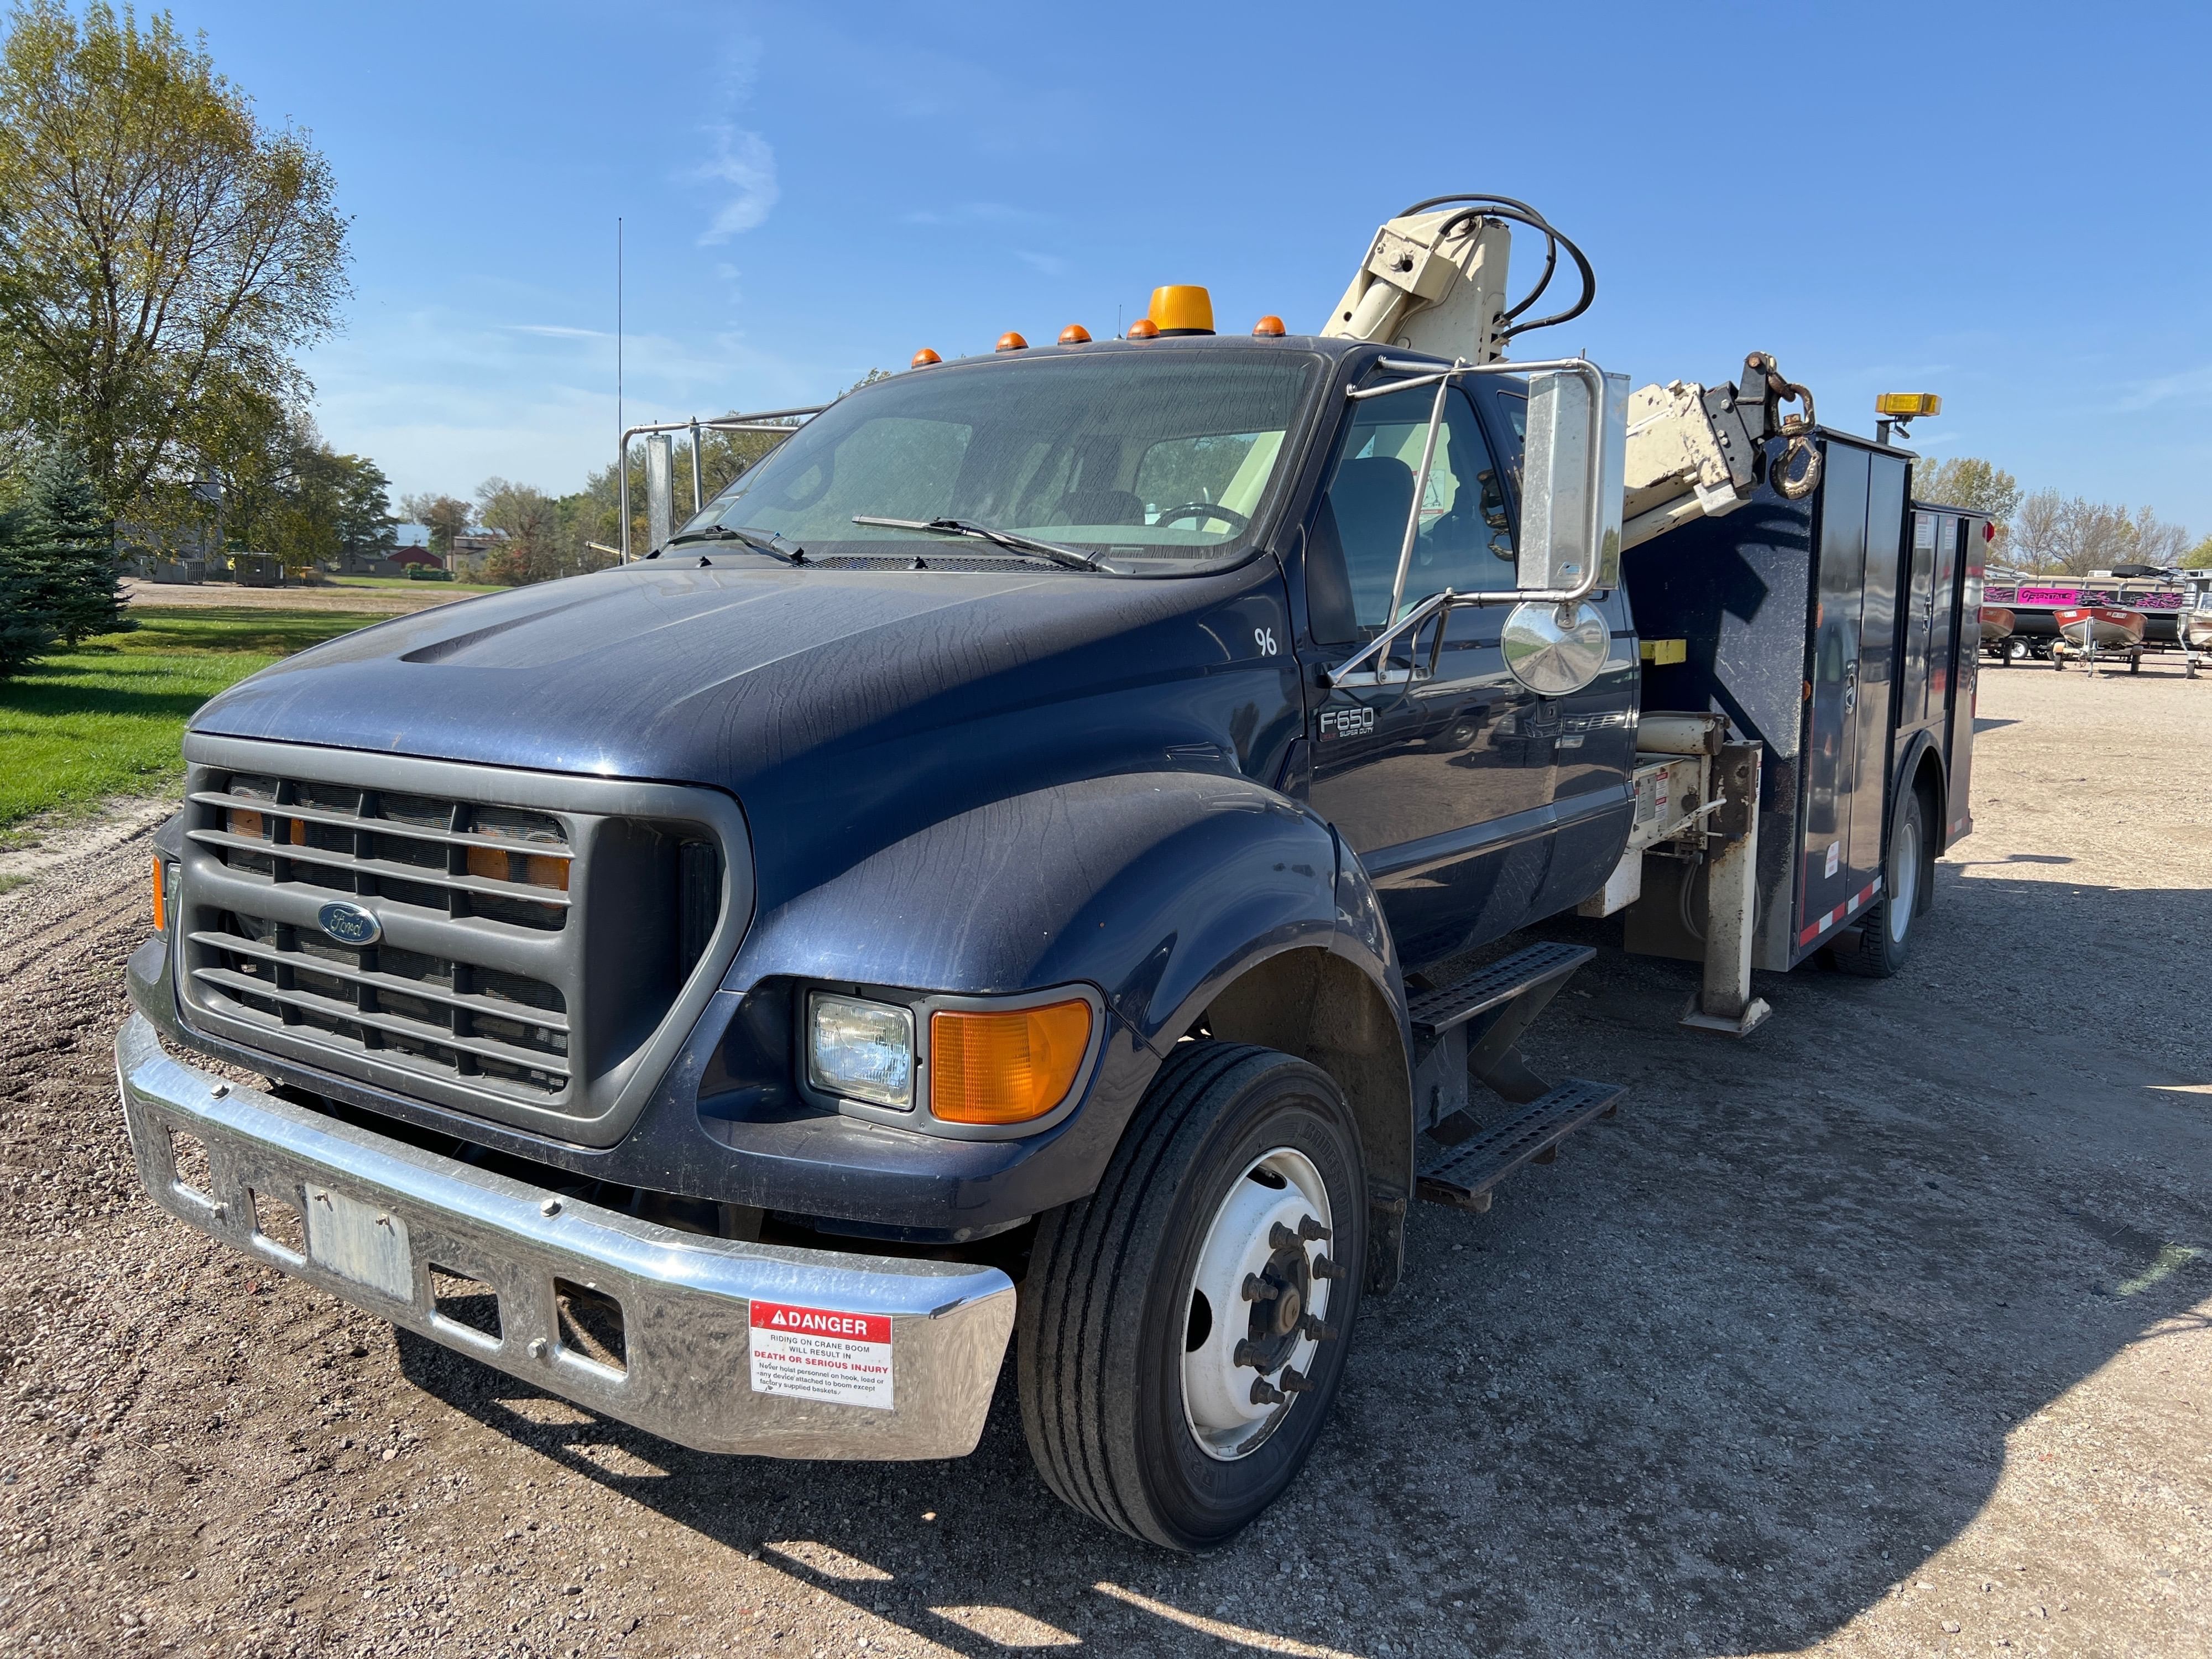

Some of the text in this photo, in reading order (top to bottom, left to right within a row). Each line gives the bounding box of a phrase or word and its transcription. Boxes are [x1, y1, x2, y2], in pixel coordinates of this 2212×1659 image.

[1254, 627, 1277, 656] 96
[330, 909, 363, 937] Ford
[1300, 1120, 1350, 1230] BRIDGESTONE
[788, 1311, 867, 1335] DANGER
[770, 1334, 797, 1344] RIDING
[815, 1340, 842, 1349] CRANE
[845, 1344, 870, 1353] BOOM
[810, 1349, 840, 1358] RESULT
[754, 1350, 785, 1361] DEATH
[805, 1358, 848, 1369] SERIOUS
[852, 1364, 889, 1374] INJURY
[760, 1378, 782, 1387] factory
[784, 1383, 811, 1391] supplied
[797, 1369, 829, 1378] personnel
[841, 1374, 859, 1382] hook,
